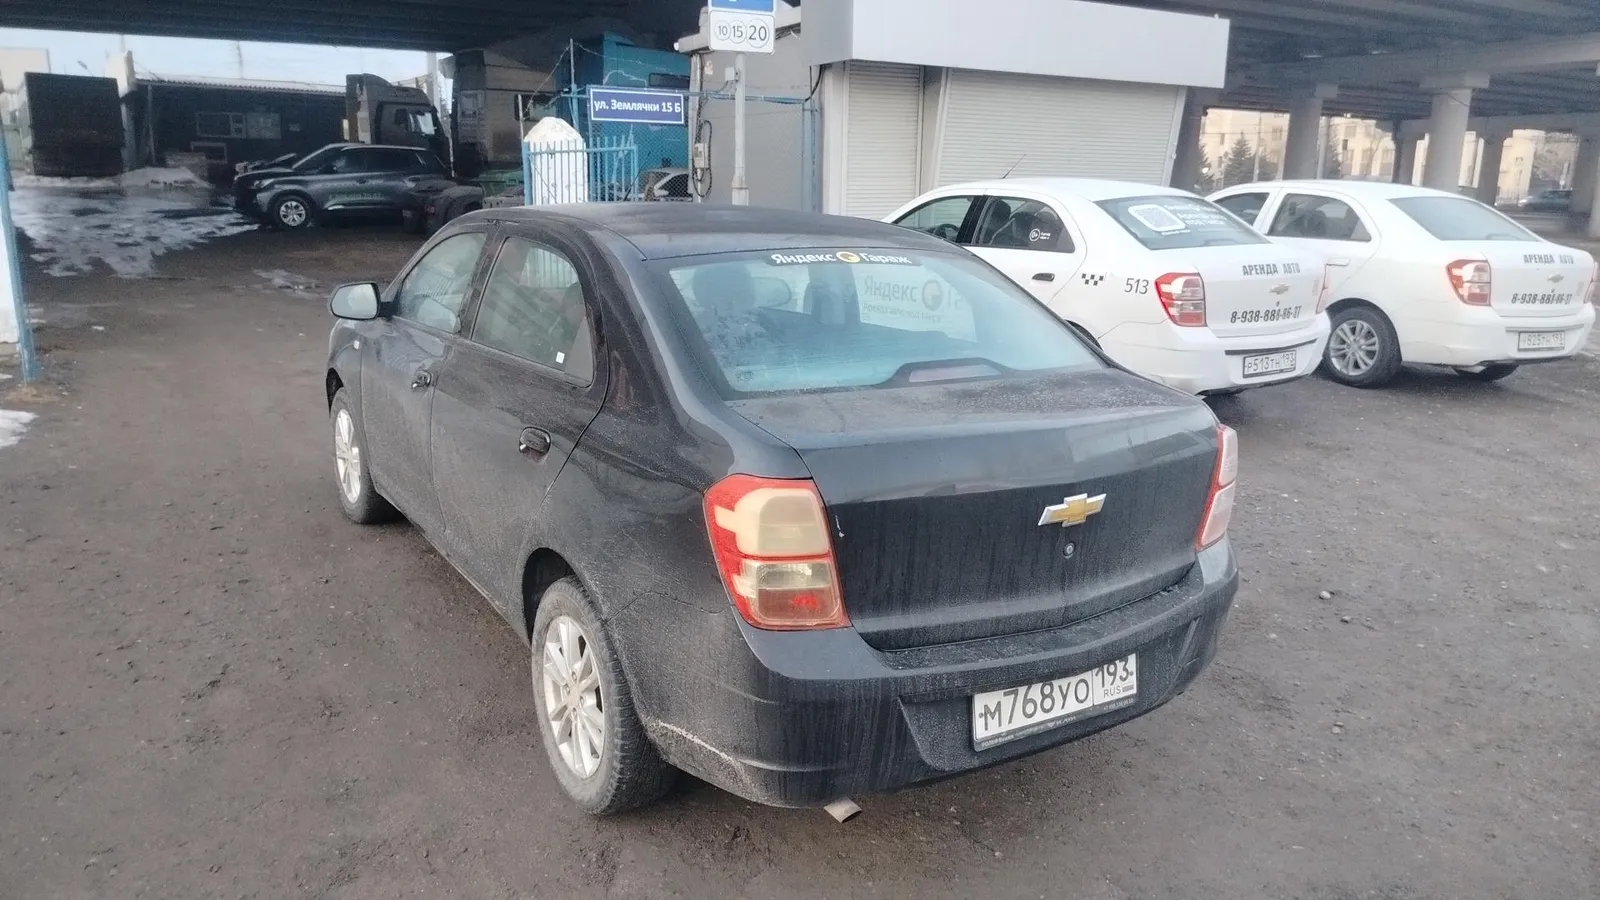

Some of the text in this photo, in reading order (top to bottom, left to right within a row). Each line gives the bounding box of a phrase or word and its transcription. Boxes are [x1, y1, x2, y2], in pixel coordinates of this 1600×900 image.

[718, 26, 768, 41] 10 15 20
[594, 99, 681, 113] ул. Землячки 15 Б
[770, 252, 912, 264] Яндекс Гараж
[1523, 254, 1555, 264] АРЕНДА
[1242, 263, 1301, 276] АРЕНДА АВТО
[863, 275, 917, 303] Яндекс
[1124, 277, 1149, 294] 513
[1281, 353, 1295, 364] 193
[983, 658, 1129, 731] М768УО 193
[1103, 684, 1122, 698] RUS
